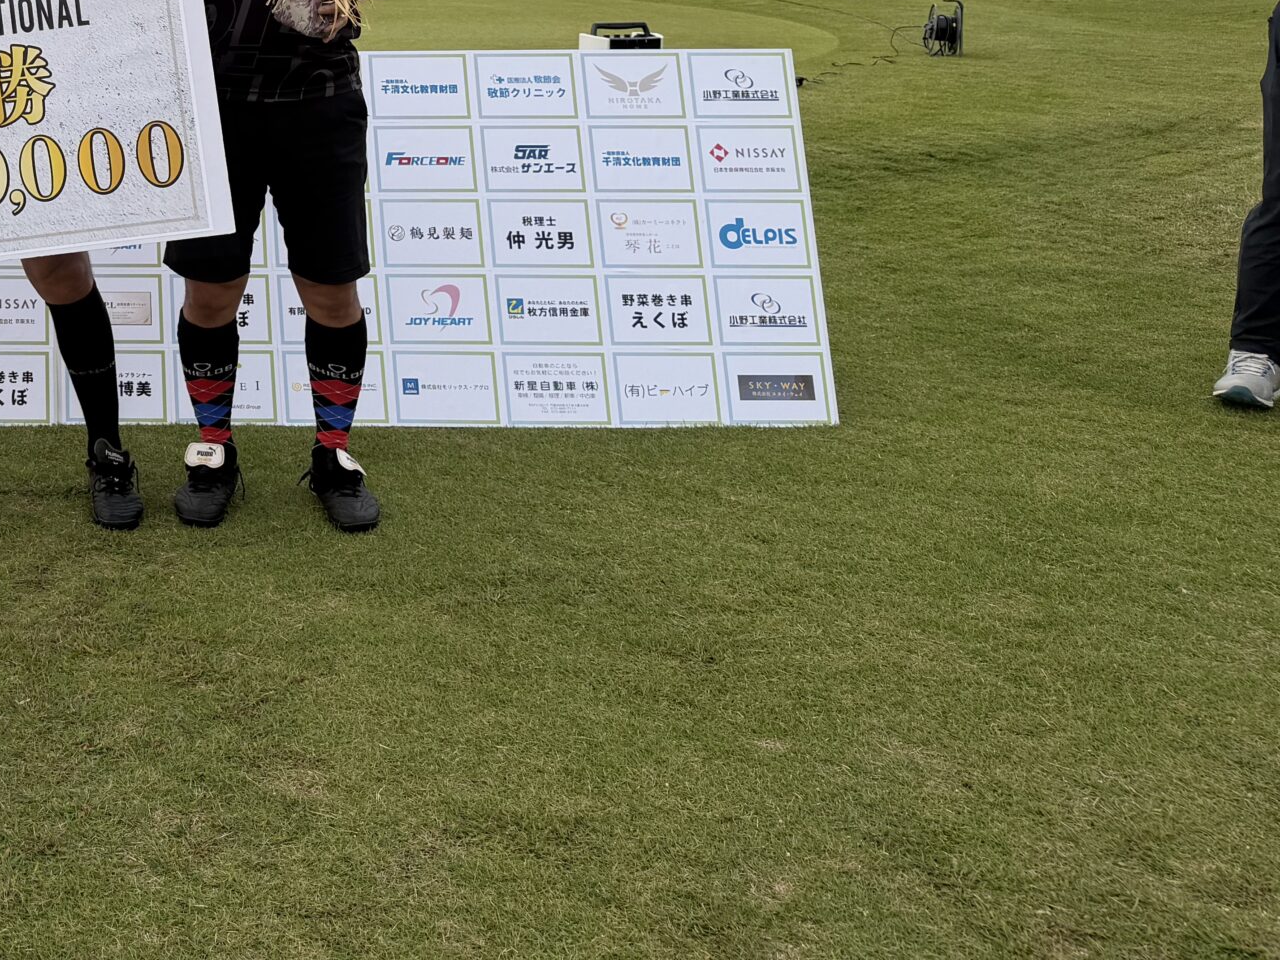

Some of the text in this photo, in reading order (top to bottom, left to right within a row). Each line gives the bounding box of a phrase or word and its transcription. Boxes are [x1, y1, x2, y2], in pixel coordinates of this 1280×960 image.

[487, 87, 566, 98] 敬節クリニック
[702, 89, 780, 100] 小野工業株式会社
[385, 152, 466, 166] FORCEONE
[735, 148, 786, 158] NISSAY
[521, 163, 577, 174] サンエース
[522, 216, 557, 227] 税理士
[410, 226, 473, 240] 鶴見製麺
[506, 231, 575, 250] 仲 光男
[621, 294, 693, 307] 野菜巻き串
[527, 307, 590, 317] 枚方信用金庫
[405, 318, 474, 326] JOY HEART
[632, 311, 688, 329] えくぼ
[729, 315, 807, 327] 小野工業株式会社
[118, 380, 152, 397] 博美
[623, 384, 709, 397] (有)ビーハイブ
